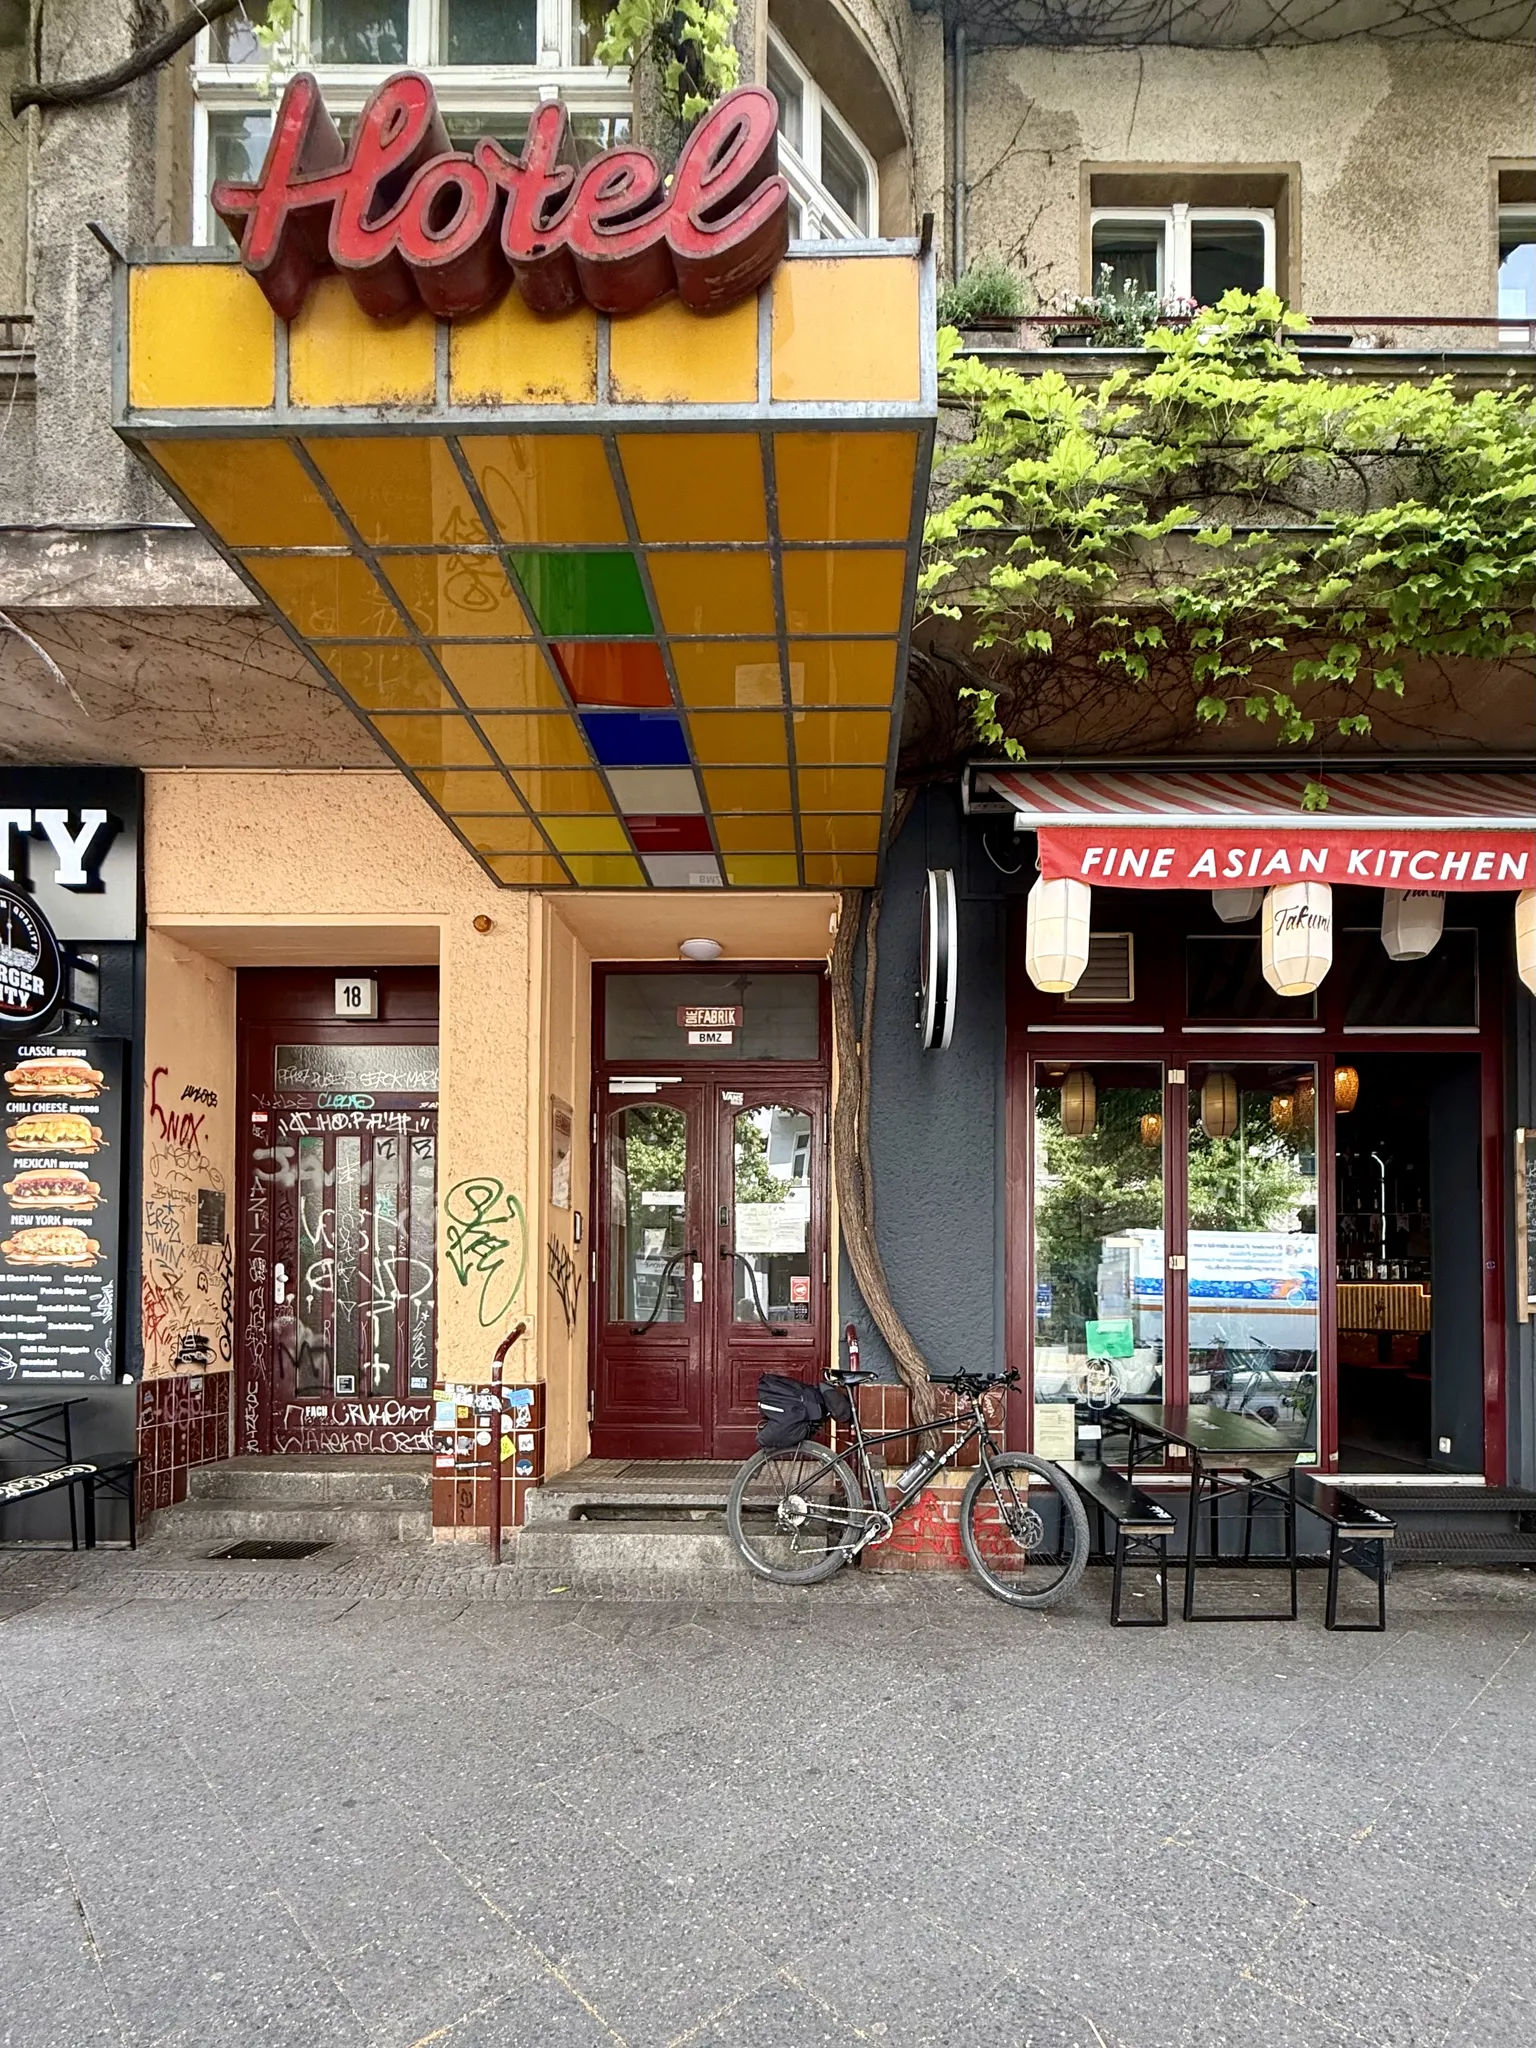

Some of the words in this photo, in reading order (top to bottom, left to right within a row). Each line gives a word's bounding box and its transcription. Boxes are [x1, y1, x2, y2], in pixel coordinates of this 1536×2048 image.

[211, 71, 788, 271] Hotel
[1081, 848, 1175, 878] FINE
[1188, 848, 1328, 878] ASIAN
[1347, 849, 1528, 880] KITCHEN
[1274, 905, 1330, 936] Takumi
[343, 986, 361, 1008] 18
[698, 1010, 736, 1024] FABRIK
[699, 1033, 722, 1043] BMZ
[18, 1046, 55, 1057] CLASSIC
[6, 1103, 31, 1113] CHILI
[33, 1103, 68, 1113] CHEESE
[14, 1159, 58, 1169] MEXICAN
[11, 1215, 34, 1225] NEW
[35, 1215, 61, 1225] YORK
[305, 1405, 328, 1417] FACH
